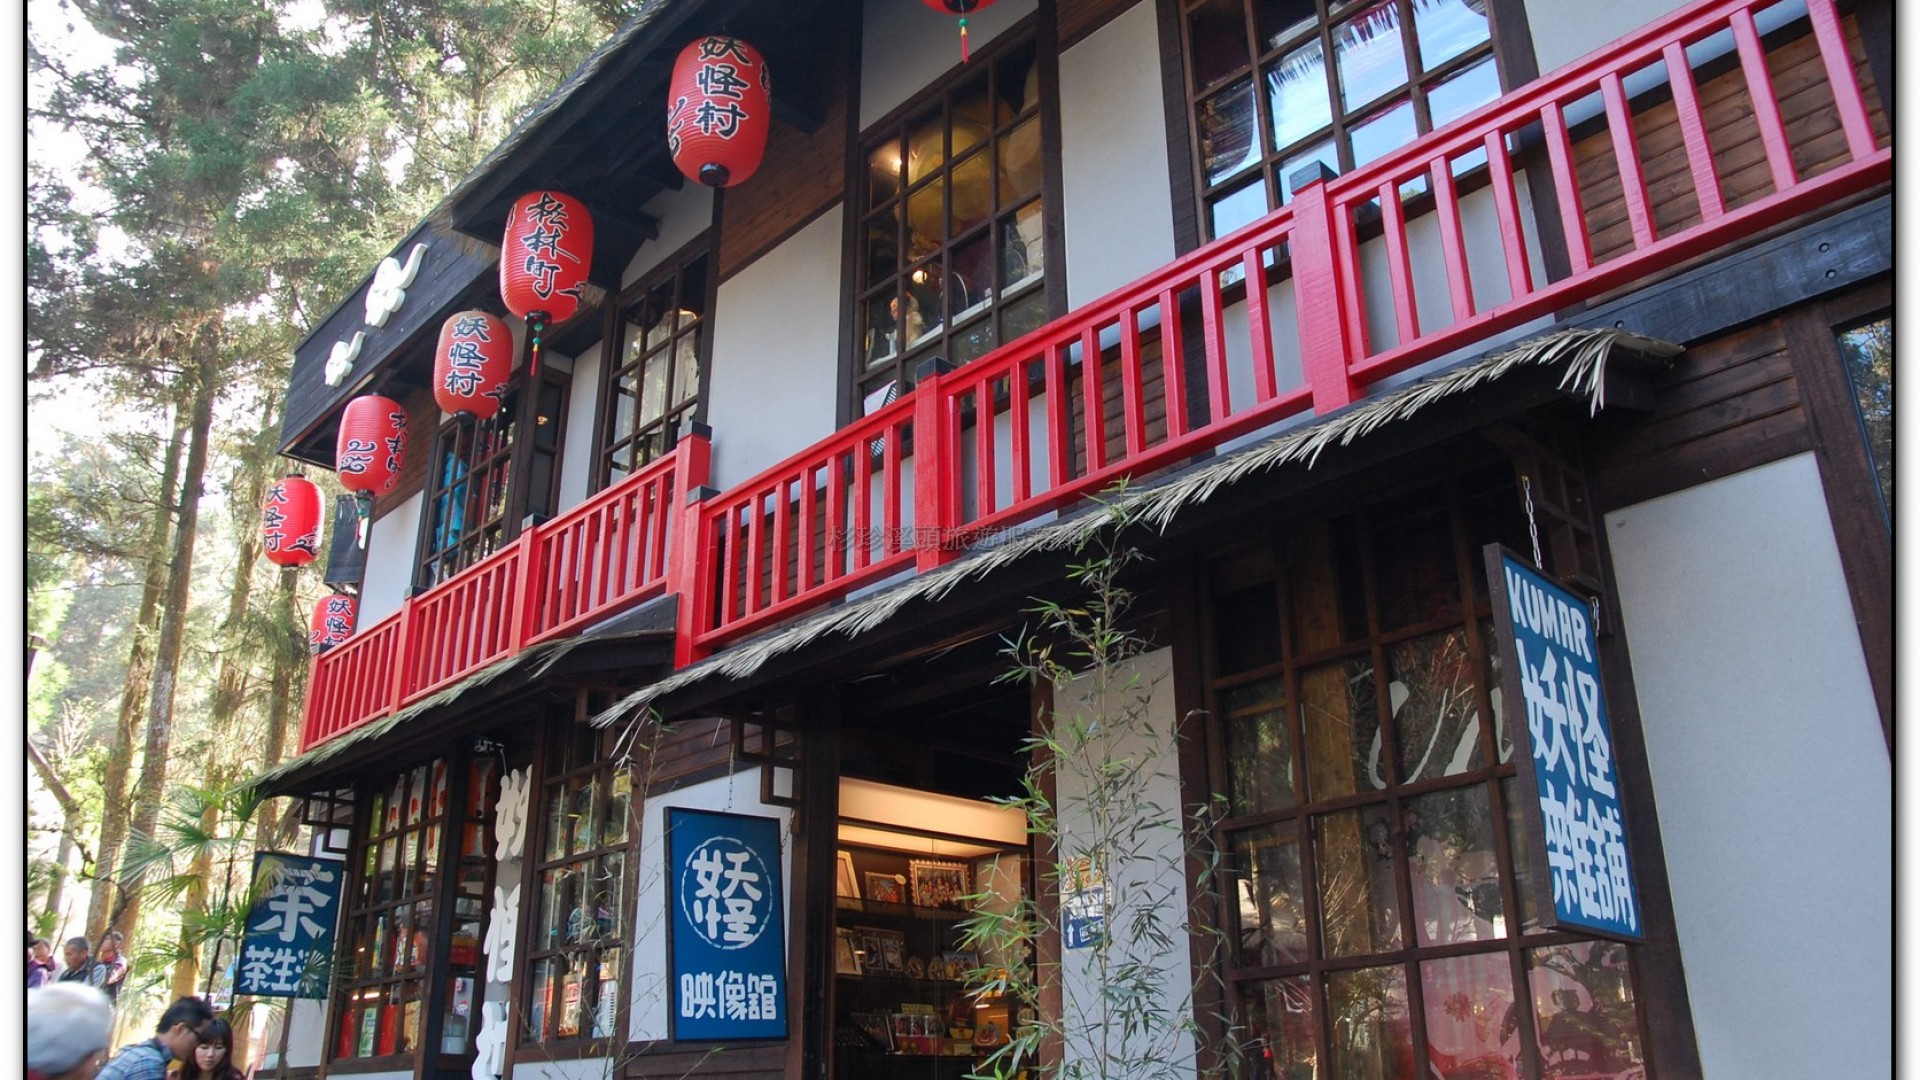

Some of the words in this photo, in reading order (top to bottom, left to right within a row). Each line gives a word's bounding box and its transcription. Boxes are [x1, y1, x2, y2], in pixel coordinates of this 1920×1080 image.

[693, 37, 752, 140] 妖怪村
[444, 317, 491, 397] 妖怪村
[1505, 566, 1592, 663] KUMAR
[1515, 638, 1616, 799] 妖怪
[692, 848, 762, 942] 妖怪
